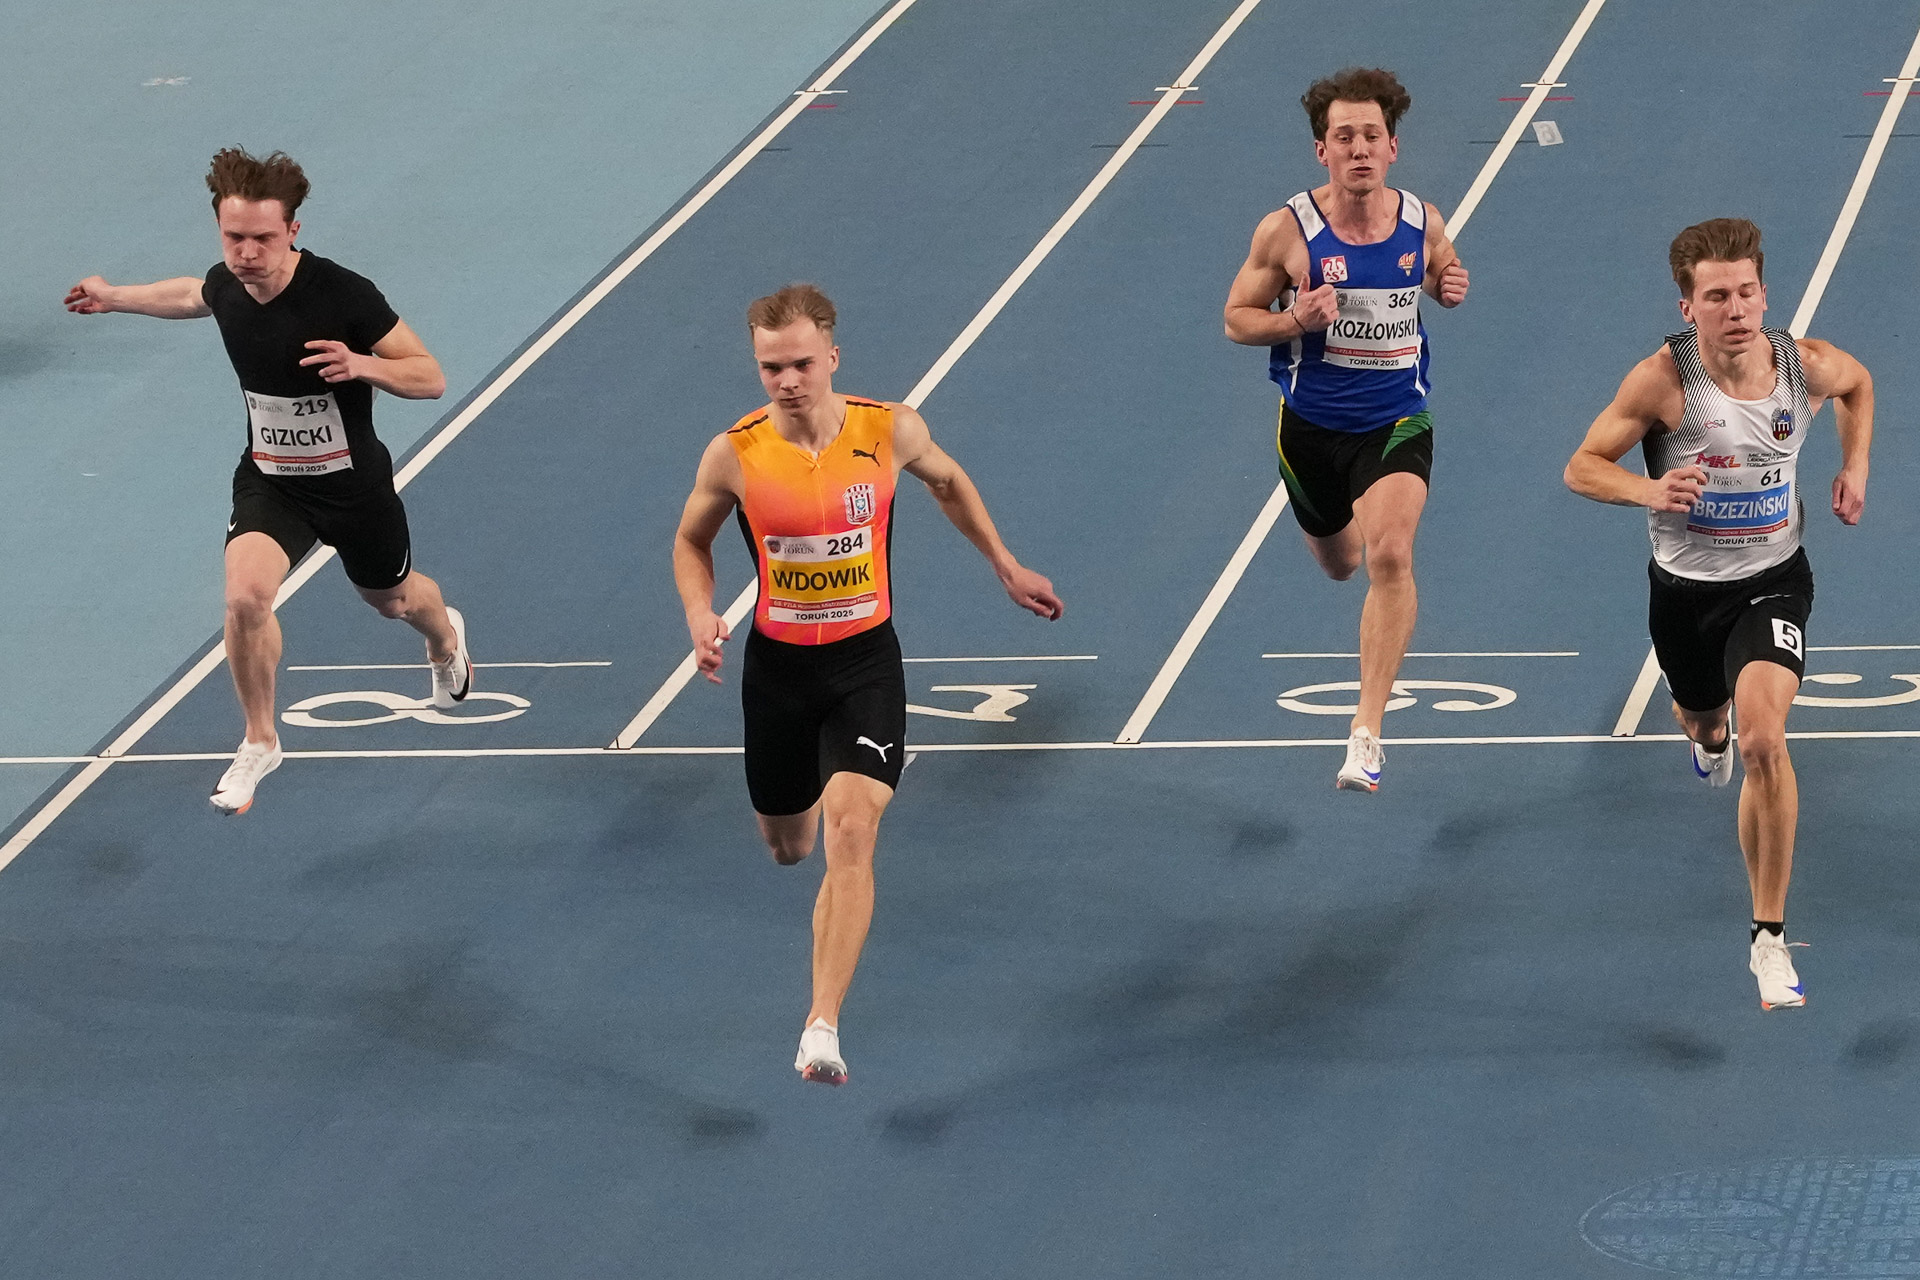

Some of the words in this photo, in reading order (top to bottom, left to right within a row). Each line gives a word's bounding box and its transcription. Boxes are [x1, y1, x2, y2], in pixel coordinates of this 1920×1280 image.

[1388, 290, 1416, 308] 362
[1332, 318, 1415, 340] KOZŁOWSKI
[1349, 358, 1378, 366] TORUŃ
[1380, 359, 1399, 367] 2025
[292, 398, 329, 417] 219
[260, 425, 333, 446] GIZICKI
[275, 463, 305, 473] TORUŃ
[305, 464, 328, 472] 2025
[1695, 452, 1742, 469] MKL
[1760, 468, 1782, 487] 61
[1693, 491, 1788, 520] BRZEZIŃSKI
[826, 532, 864, 556] 284
[1713, 537, 1745, 545] TORUŃ
[771, 562, 871, 591] WDOWIK
[795, 611, 829, 621] TORUŃ
[830, 609, 854, 618] 2025
[1781, 623, 1798, 650] 5
[281, 690, 531, 728] 8
